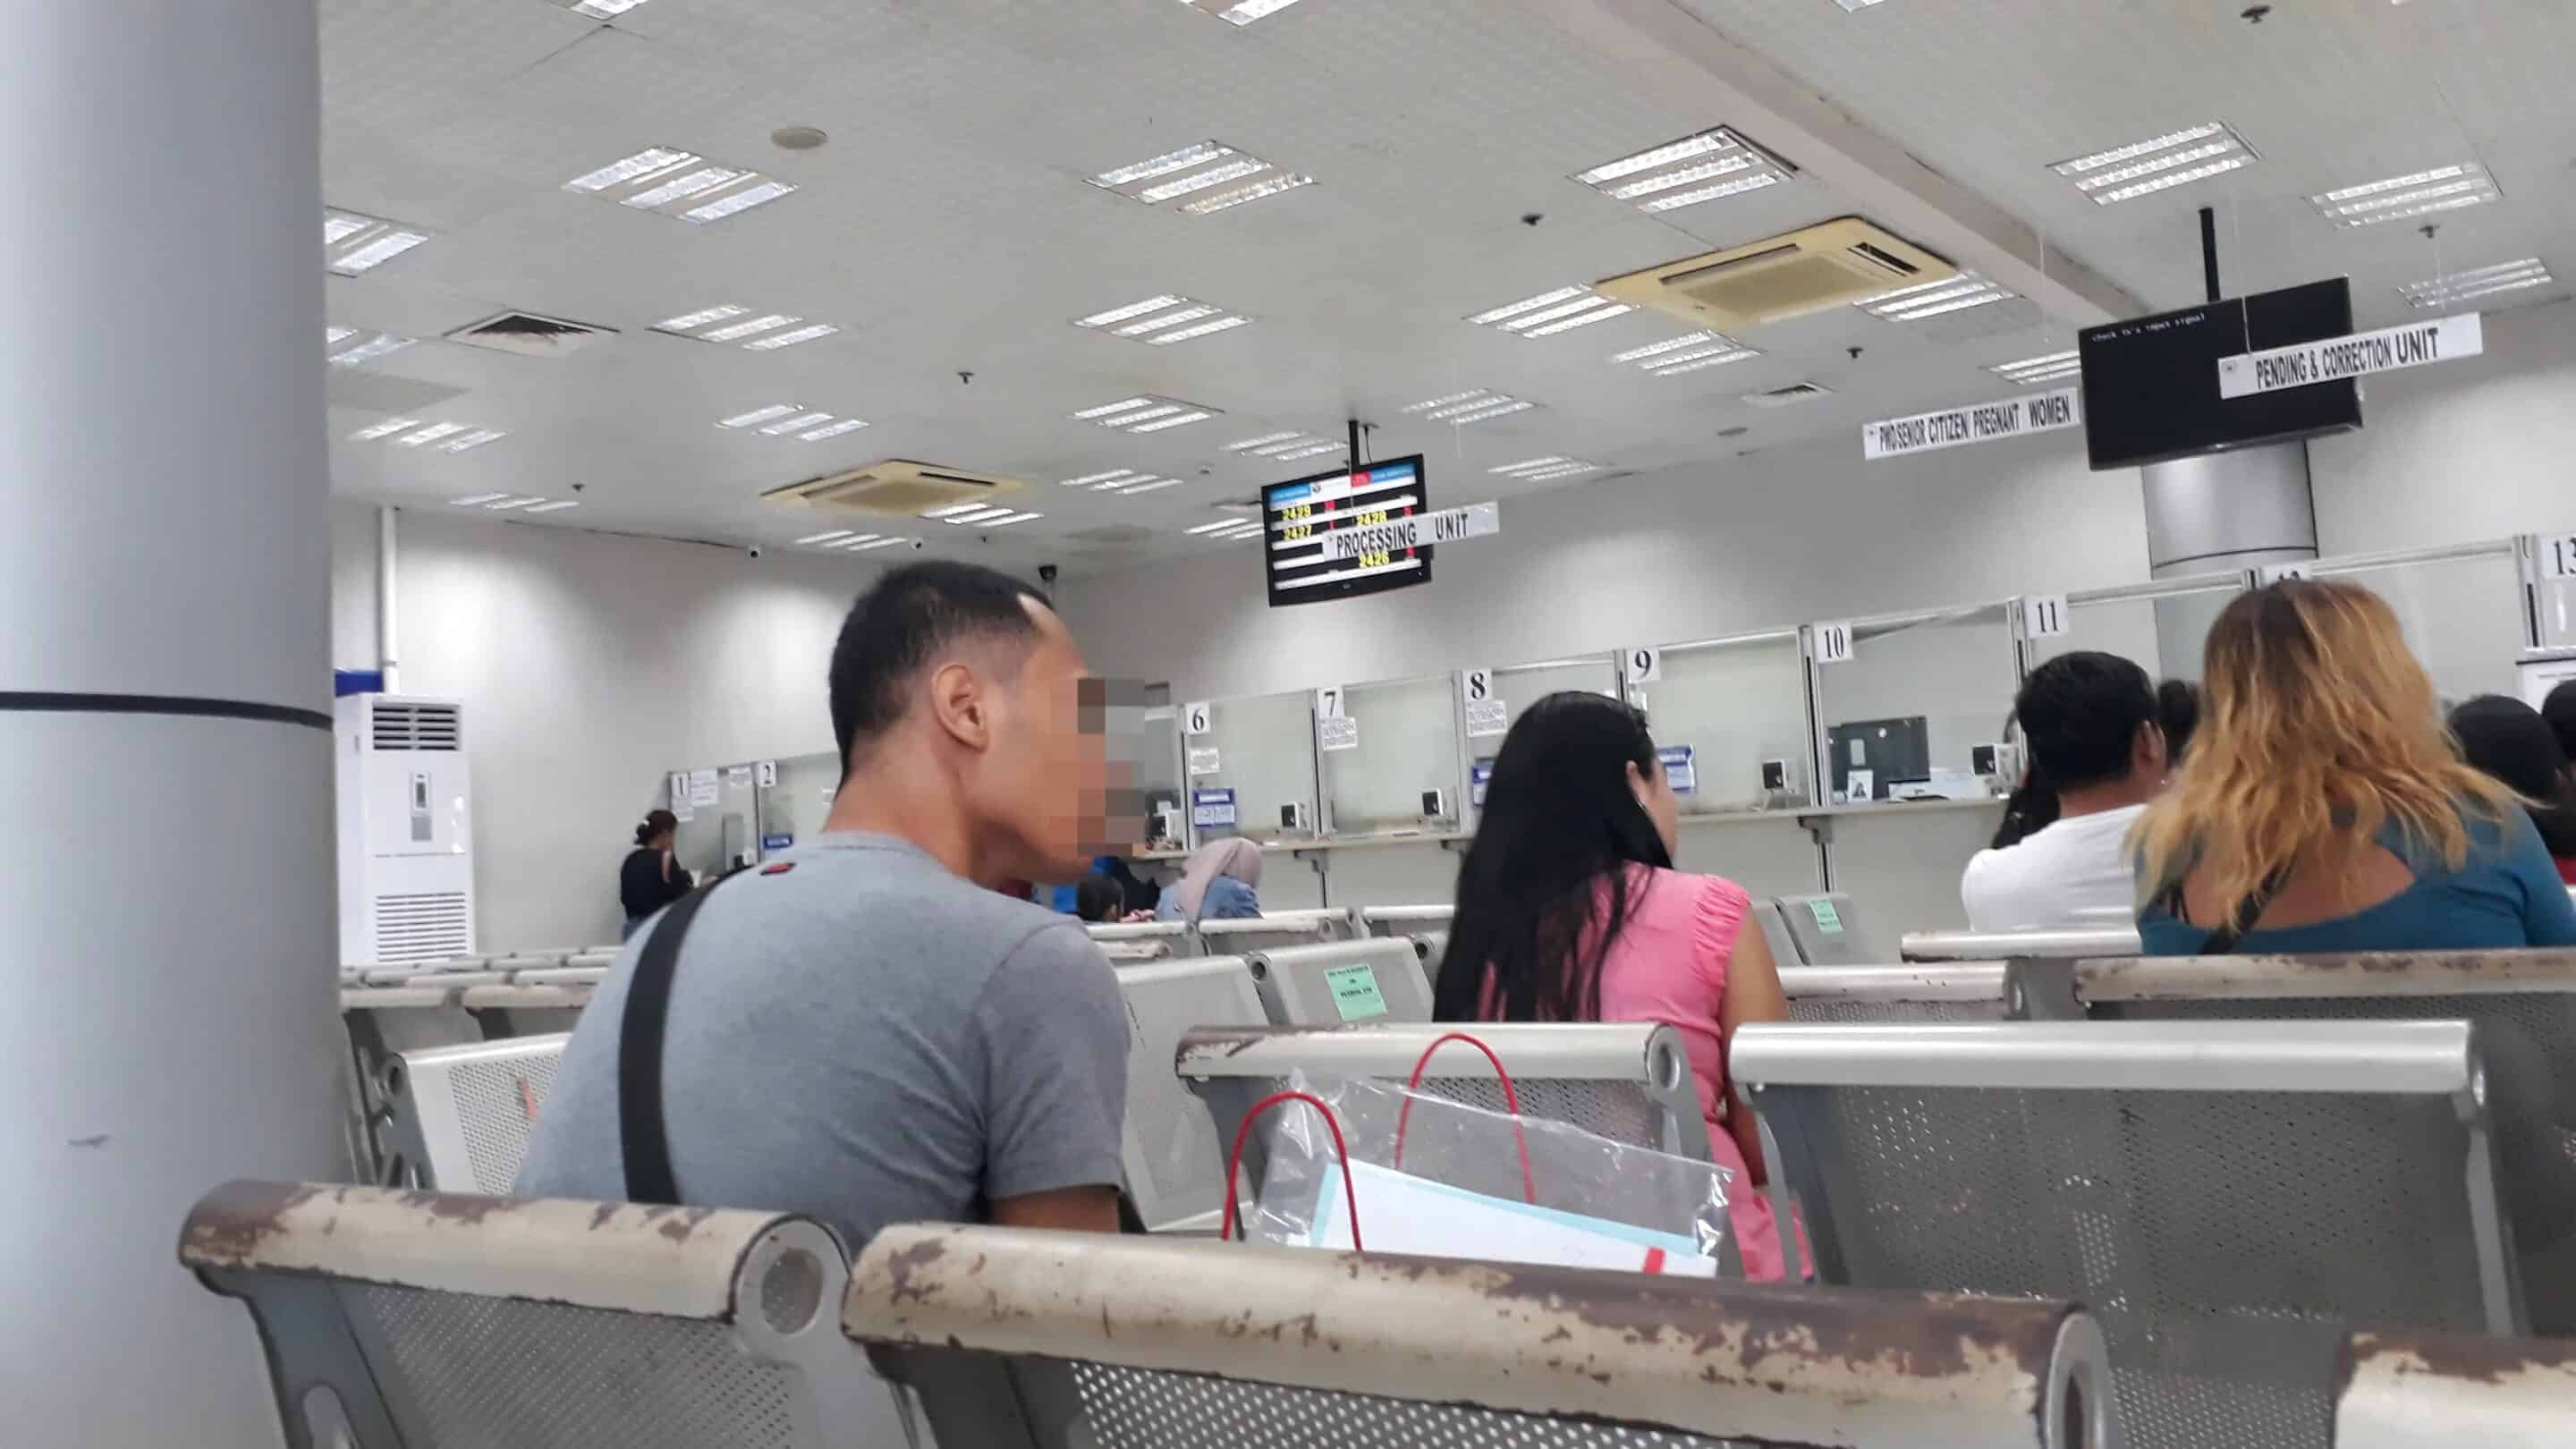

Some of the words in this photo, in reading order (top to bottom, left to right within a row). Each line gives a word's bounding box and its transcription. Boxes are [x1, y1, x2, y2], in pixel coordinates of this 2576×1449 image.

[2256, 352, 2308, 390] PENDING
[2309, 350, 2319, 380] &
[2323, 335, 2392, 377] CORRECTION
[2396, 326, 2439, 364] UNIT
[1928, 412, 1969, 445] CITIZEN
[1972, 402, 2020, 437] PREGNANT
[2028, 395, 2072, 428] WOMEN
[1335, 521, 1419, 558] PROCESSING
[1434, 513, 1470, 540] UNIT
[2037, 600, 2061, 633] 11
[1824, 625, 1846, 659] 10
[1634, 649, 1652, 678] 9
[1470, 672, 1486, 700] 8
[1192, 708, 1206, 731] 6
[1324, 691, 1337, 716] 7
